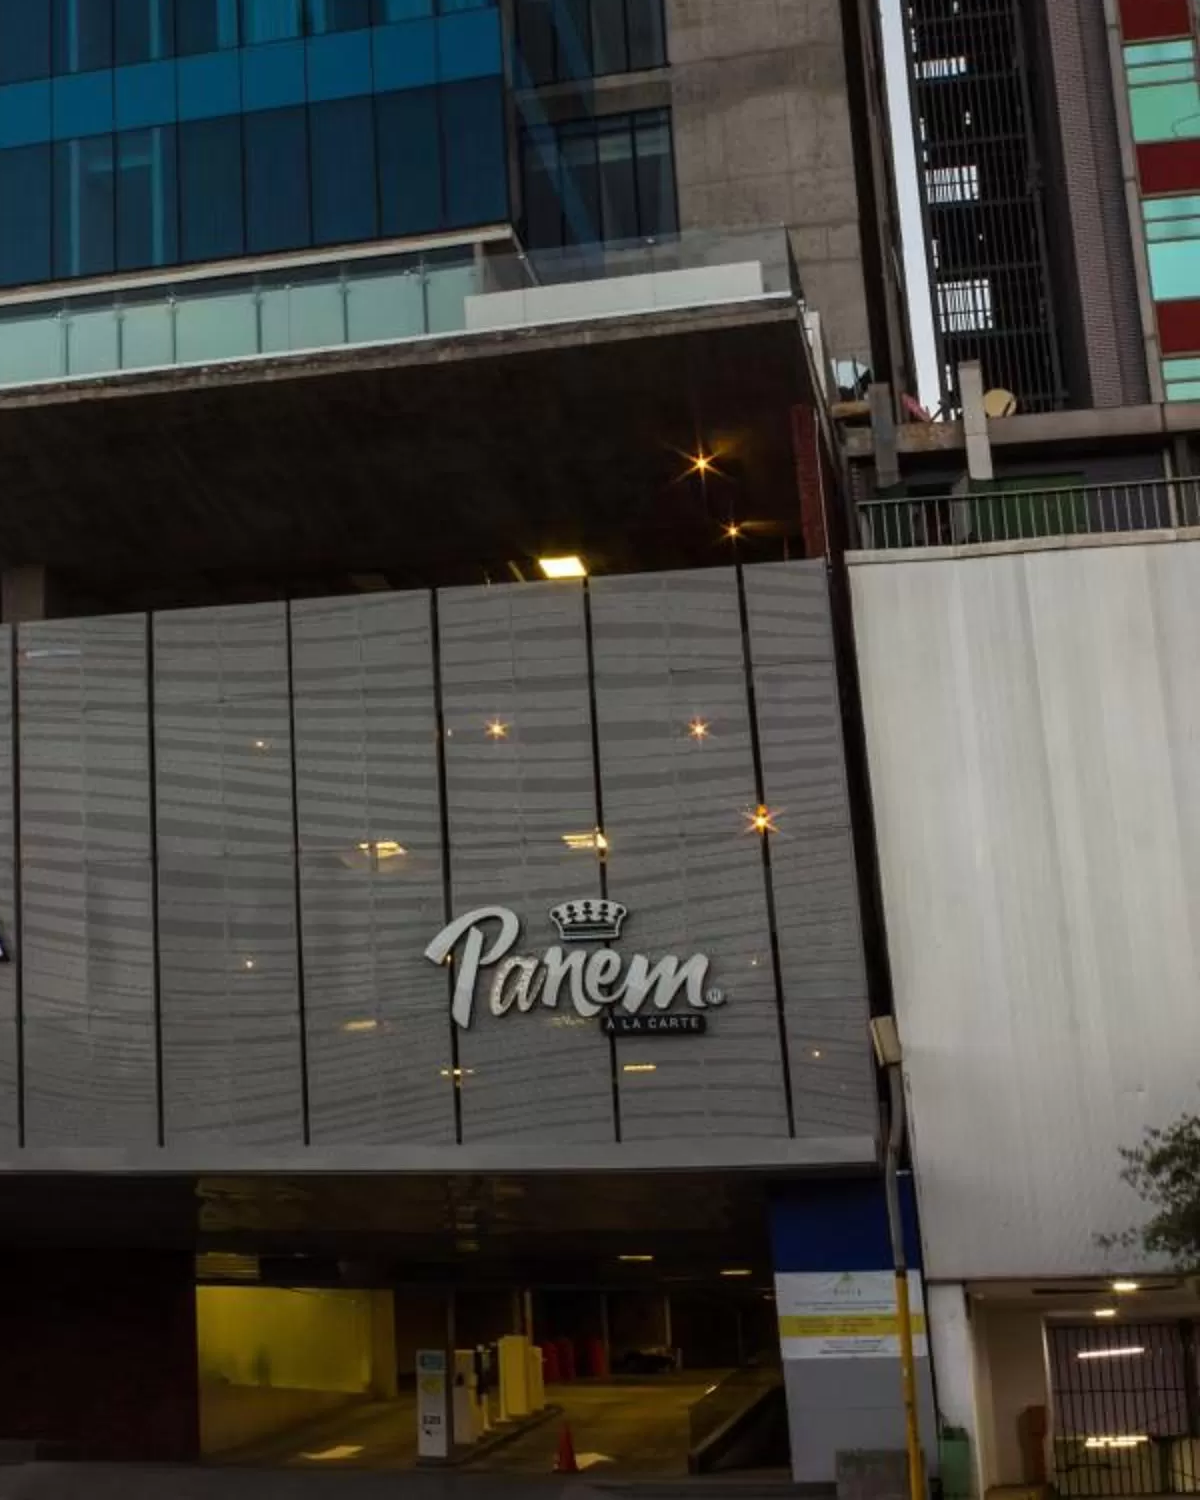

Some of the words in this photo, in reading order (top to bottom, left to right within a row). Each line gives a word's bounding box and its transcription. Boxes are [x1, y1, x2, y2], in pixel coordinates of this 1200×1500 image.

[423, 905, 709, 1028] Panem
[622, 1017, 642, 1030] LA
[647, 1016, 700, 1030] CARTE
